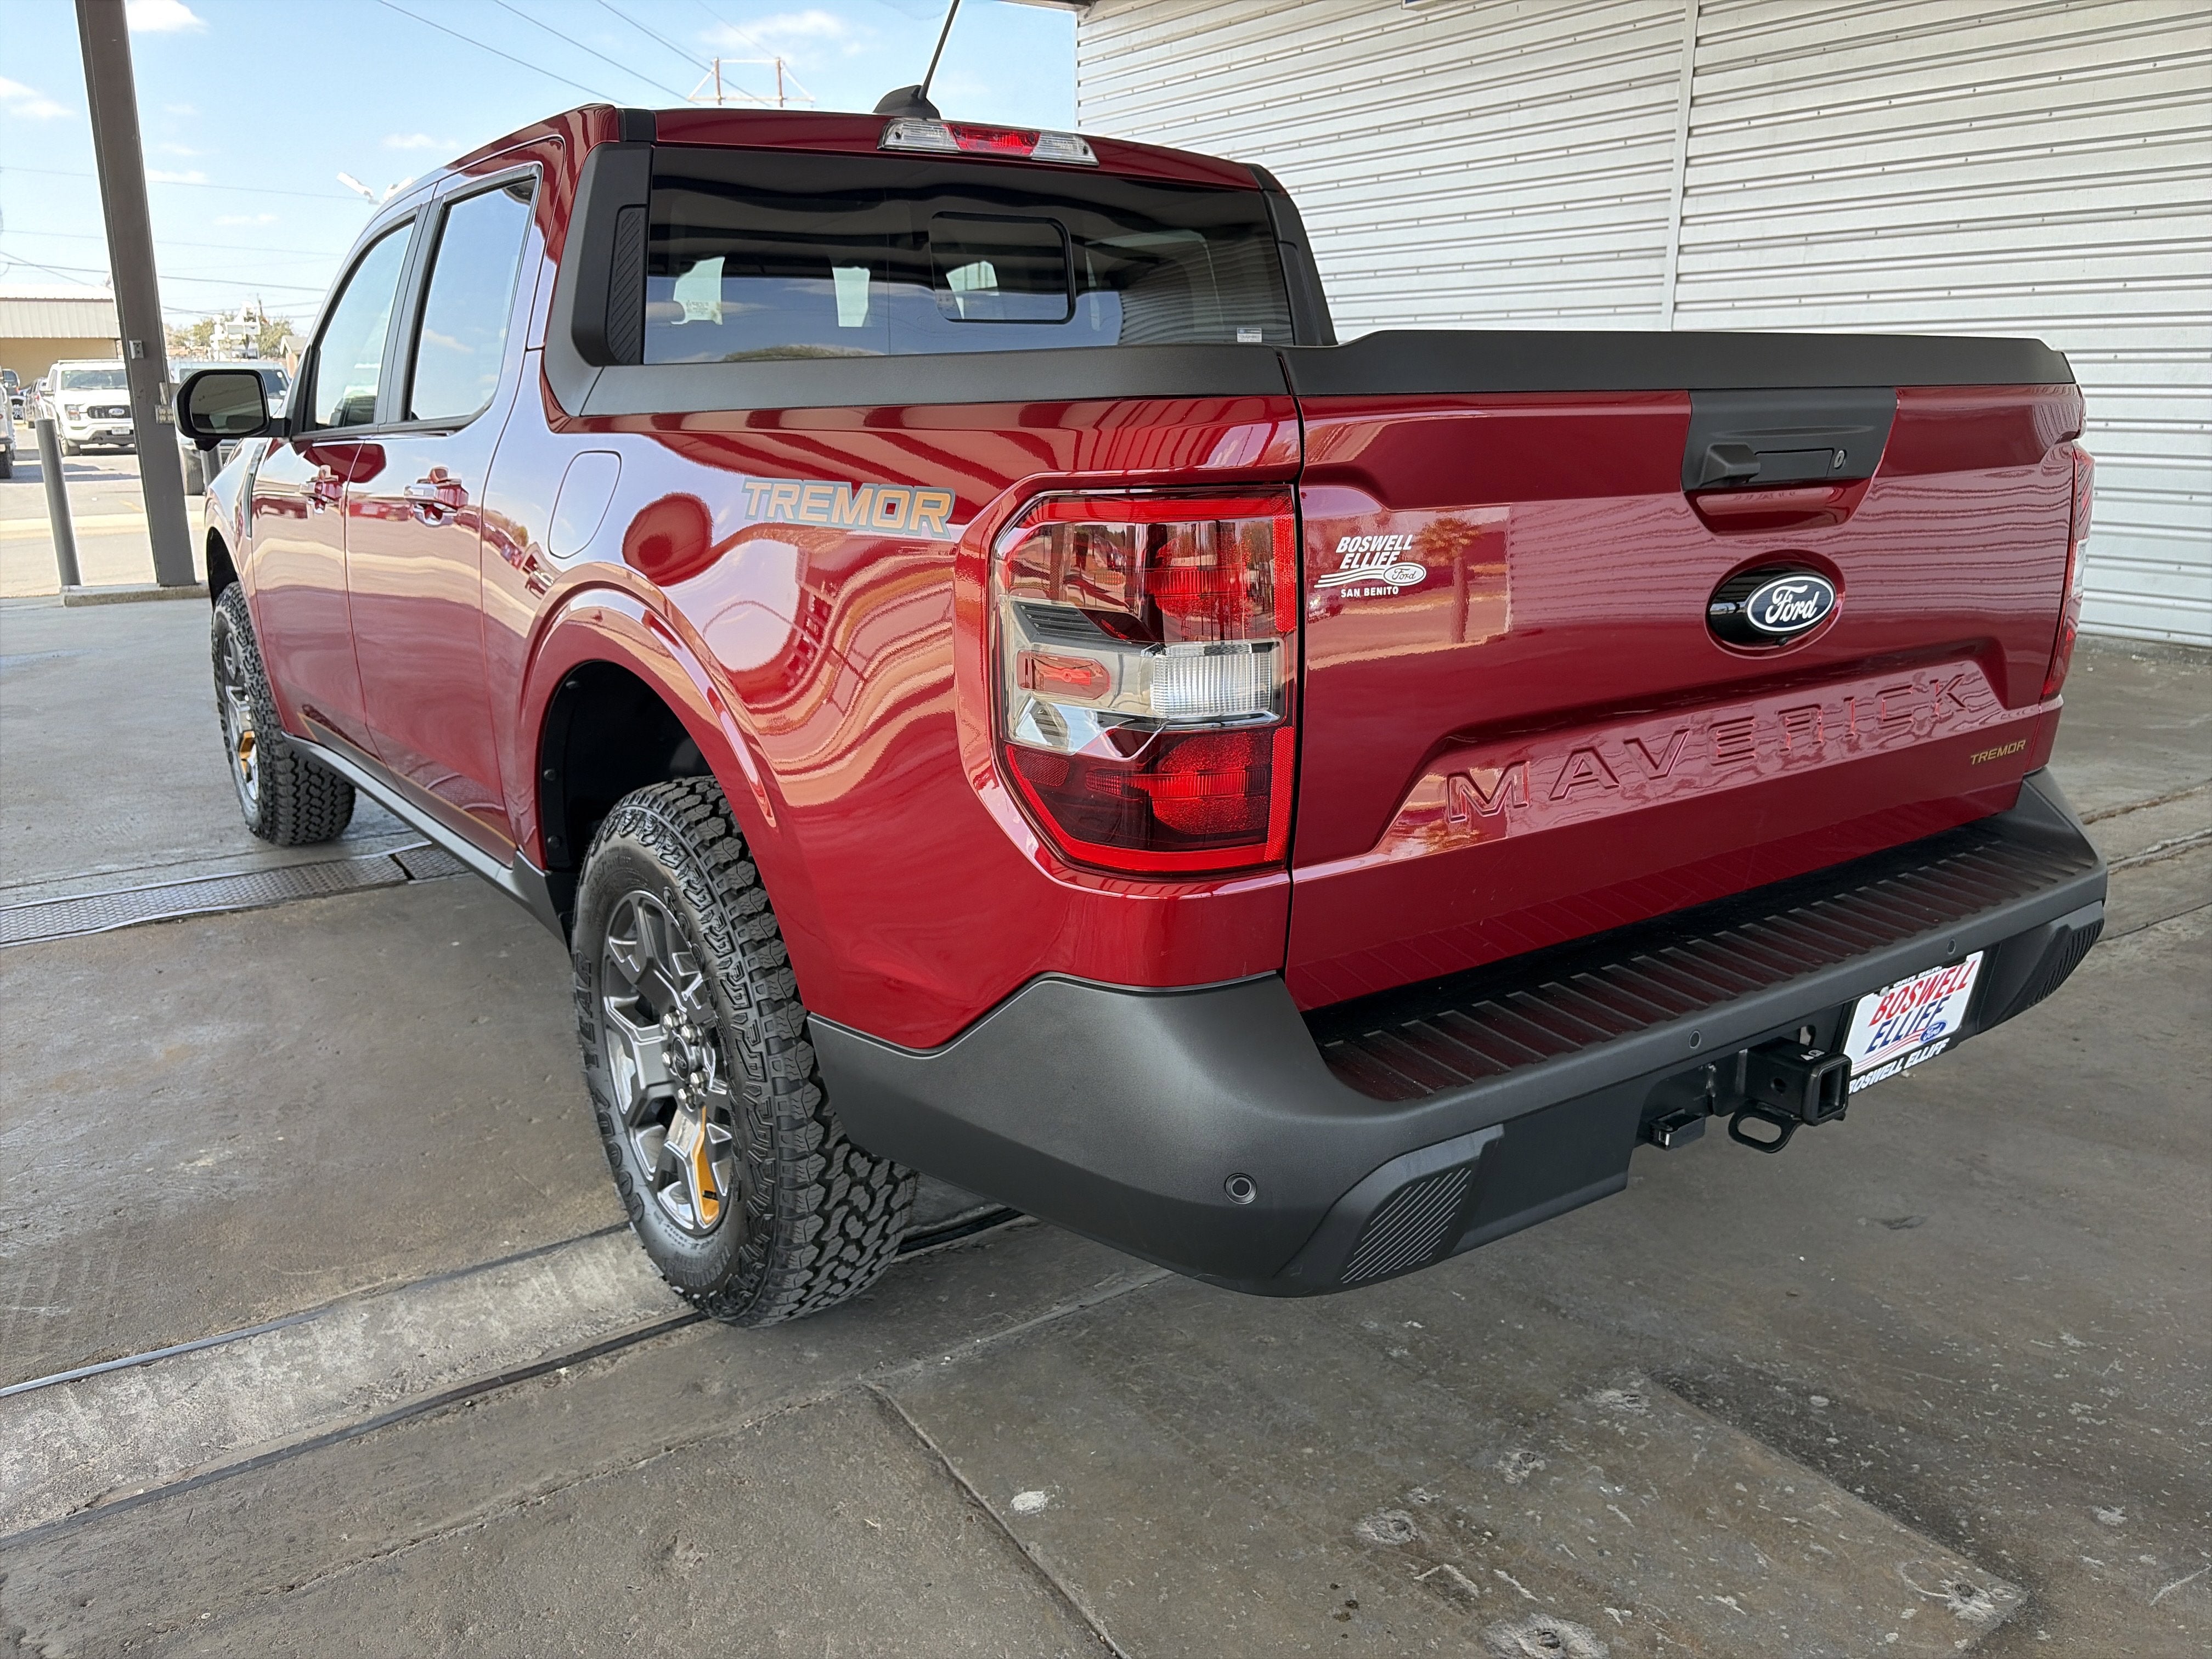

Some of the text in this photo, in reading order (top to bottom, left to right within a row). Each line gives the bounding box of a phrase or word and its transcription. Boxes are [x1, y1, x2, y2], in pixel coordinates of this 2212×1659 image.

[742, 478, 955, 539] TREMOR
[1335, 534, 1413, 553] BOSWELL
[1339, 551, 1401, 569] ELLIFF
[1341, 586, 1398, 597] SAN BENITO
[1765, 584, 1820, 624] Ford
[1445, 674, 1966, 823] MAVERICK
[1970, 739, 2026, 765] TREMOR
[1868, 960, 1977, 1028] BOSWELL
[1864, 994, 1951, 1055] ELLIFF
[1904, 1037, 1950, 1070] ELLIFF
